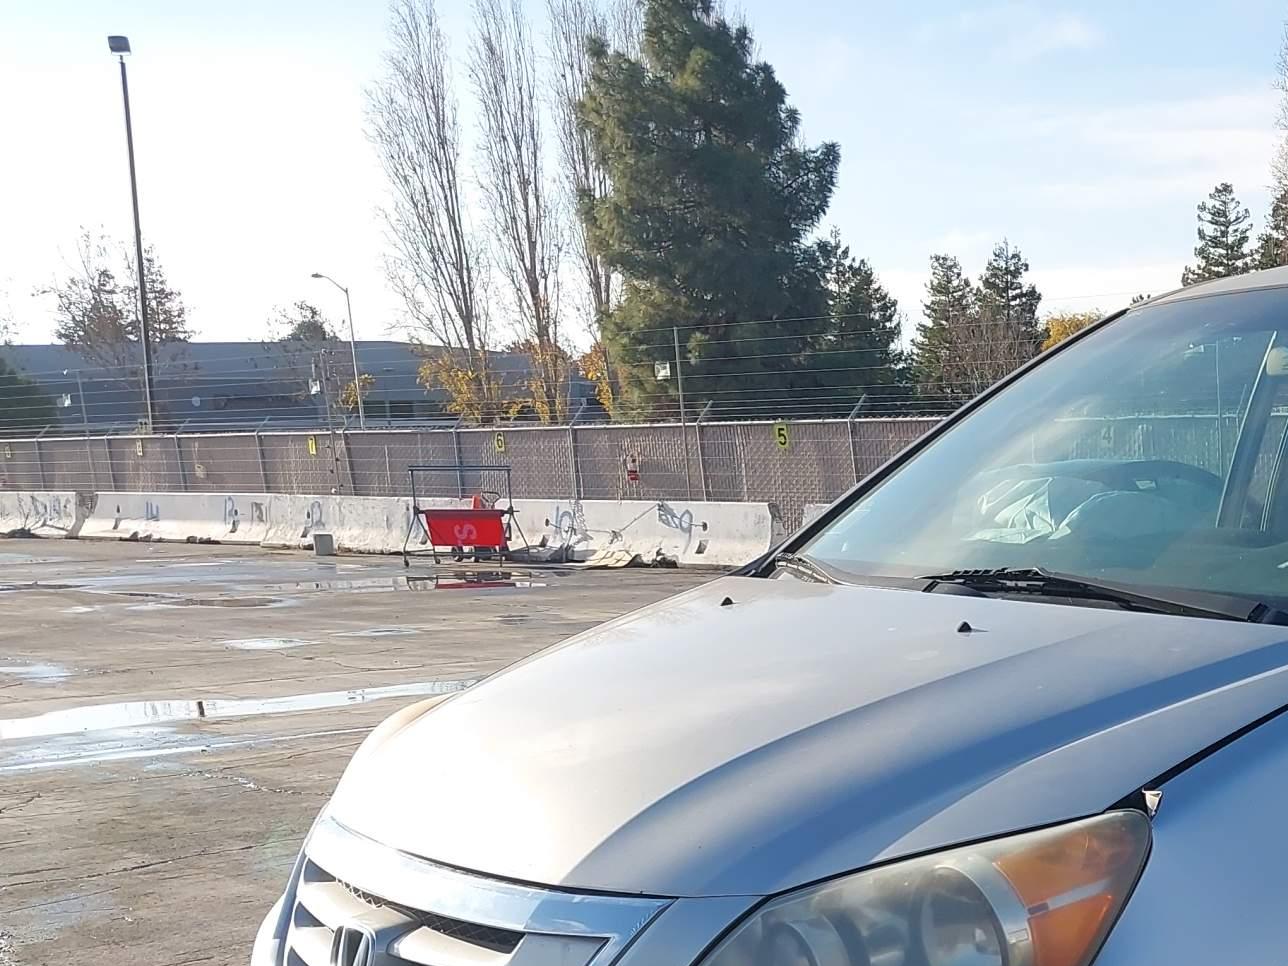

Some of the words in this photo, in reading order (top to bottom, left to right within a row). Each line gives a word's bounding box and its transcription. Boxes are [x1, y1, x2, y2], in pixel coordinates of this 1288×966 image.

[496, 432, 504, 449] 6
[777, 427, 787, 446] 5
[1102, 425, 1113, 445] 4
